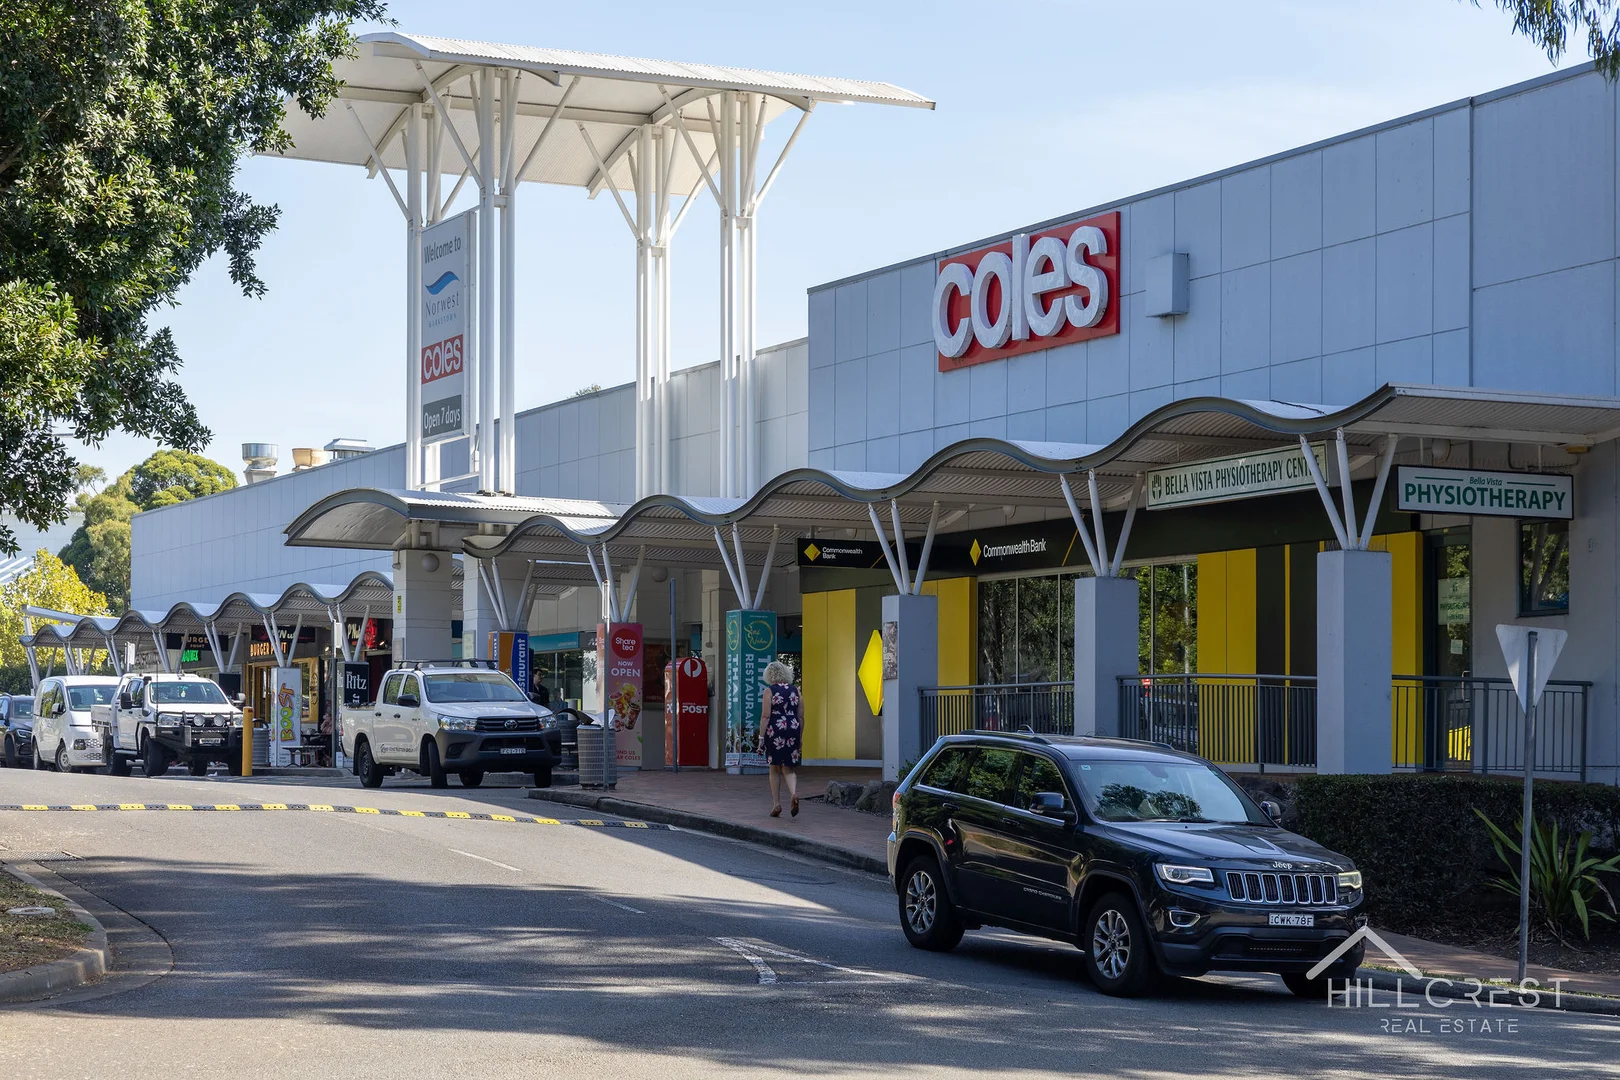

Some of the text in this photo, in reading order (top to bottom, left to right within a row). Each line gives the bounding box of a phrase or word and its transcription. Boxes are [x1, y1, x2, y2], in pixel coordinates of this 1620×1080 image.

[424, 236, 461, 264] Welcome to
[932, 226, 1108, 357] coles
[425, 291, 459, 317] Norwest
[423, 338, 461, 380] coles
[423, 405, 460, 433] Open 7 days
[1165, 473, 1188, 496] BELLA
[1191, 470, 1213, 492] VISTA
[1215, 459, 1283, 489] PHYSIOTHERAPY
[1469, 476, 1503, 486] Bella Vista
[1405, 483, 1566, 511] PHYSIOTHERAPY
[822, 546, 863, 555] Commonwealth
[983, 537, 1047, 558] Commonwealth Bank
[250, 642, 270, 657] BURGER
[615, 636, 636, 645] Share
[346, 674, 367, 689] Ritz
[611, 667, 640, 677] OPEN
[745, 653, 754, 736] RESTAURANT
[278, 682, 294, 741] BOOST
[682, 705, 708, 714] POST
[1272, 861, 1293, 870] Jeep
